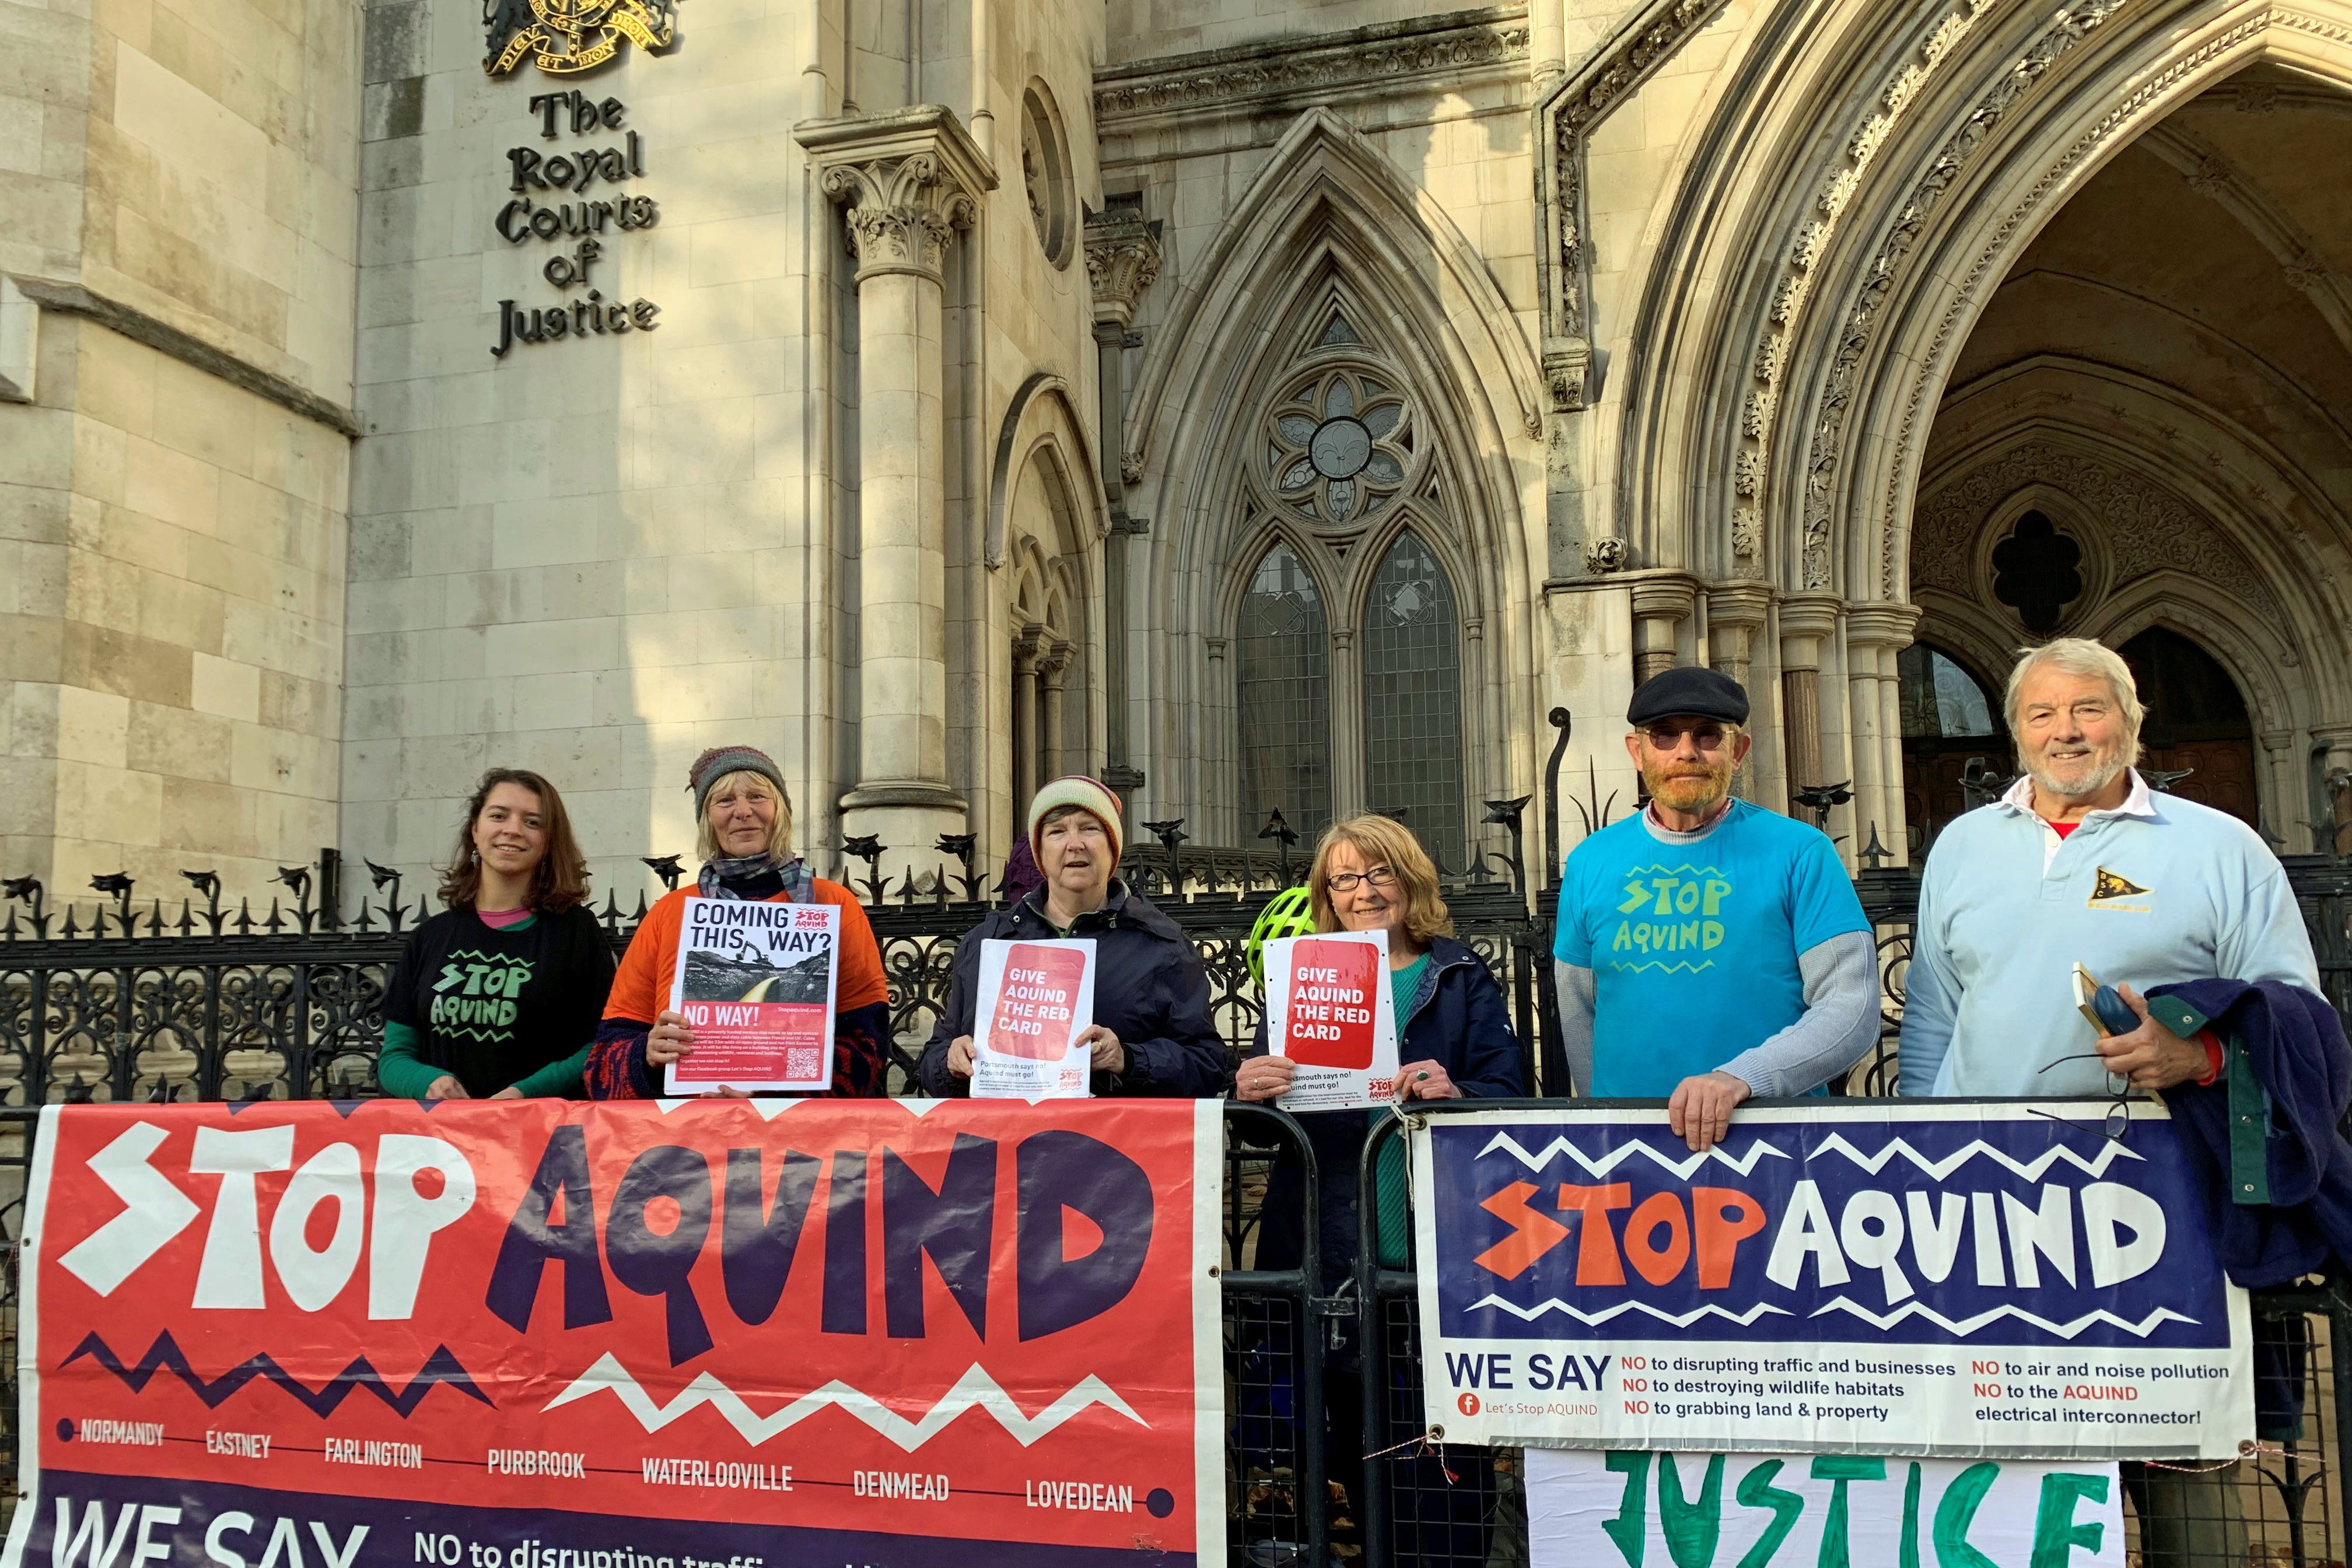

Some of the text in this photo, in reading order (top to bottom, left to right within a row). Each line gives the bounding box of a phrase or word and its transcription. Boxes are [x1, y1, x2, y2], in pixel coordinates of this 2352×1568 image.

[610, 13, 653, 47] DROIT
[529, 89, 623, 138] The
[506, 130, 641, 194] Royal
[494, 192, 652, 243] Courts
[543, 237, 600, 287] of
[490, 289, 656, 356] Justice
[1616, 878, 1732, 916] STOP
[694, 903, 789, 929] COMING
[794, 910, 830, 921] STOP
[691, 926, 831, 953] THIS WAY?
[431, 963, 532, 998] STOP
[1010, 968, 1047, 984] GIVE
[1297, 967, 1338, 984] GIVE
[1005, 985, 1067, 1003] AQUIND
[1294, 985, 1364, 1004] AQUIND
[684, 1005, 759, 1027] NO WAY!
[1003, 1000, 1069, 1021] THE RED
[1294, 1004, 1370, 1024] THE RED
[998, 1017, 1042, 1035] CARD
[1292, 1023, 1341, 1041] CARD
[979, 1069, 1003, 1077] Aquind
[981, 1060, 1019, 1069] Portsmouth
[1288, 1083, 1306, 1093] uind
[1327, 1082, 1339, 1090] go!
[57, 1120, 477, 1322] STOP
[1473, 1180, 1767, 1290] STOP
[1444, 1352, 1612, 1392] WE SAY
[1622, 1357, 1956, 1376] NO to disrupting traffic and businesses
[1972, 1361, 2229, 1382] NO to air and noise pollution
[1623, 1379, 1905, 1396] NO to destroying wildlife habitats
[1974, 1383, 2137, 1401] NO to the AQUIND
[1486, 1402, 1513, 1414] Let's
[1517, 1403, 1544, 1416] Stop
[1547, 1404, 1597, 1416] AQUIND
[1624, 1401, 1888, 1423] NO to grabbing land & property
[1976, 1407, 2202, 1424] electrical interconnector!
[80, 1419, 1132, 1513] NORMANDY EASTNEY FARLINGTON PURBROOK WATERLOOVILLE DENMEAD LOVEDEAN
[55, 1497, 182, 1568] WE
[415, 1532, 461, 1566] NO
[469, 1542, 502, 1568] to
